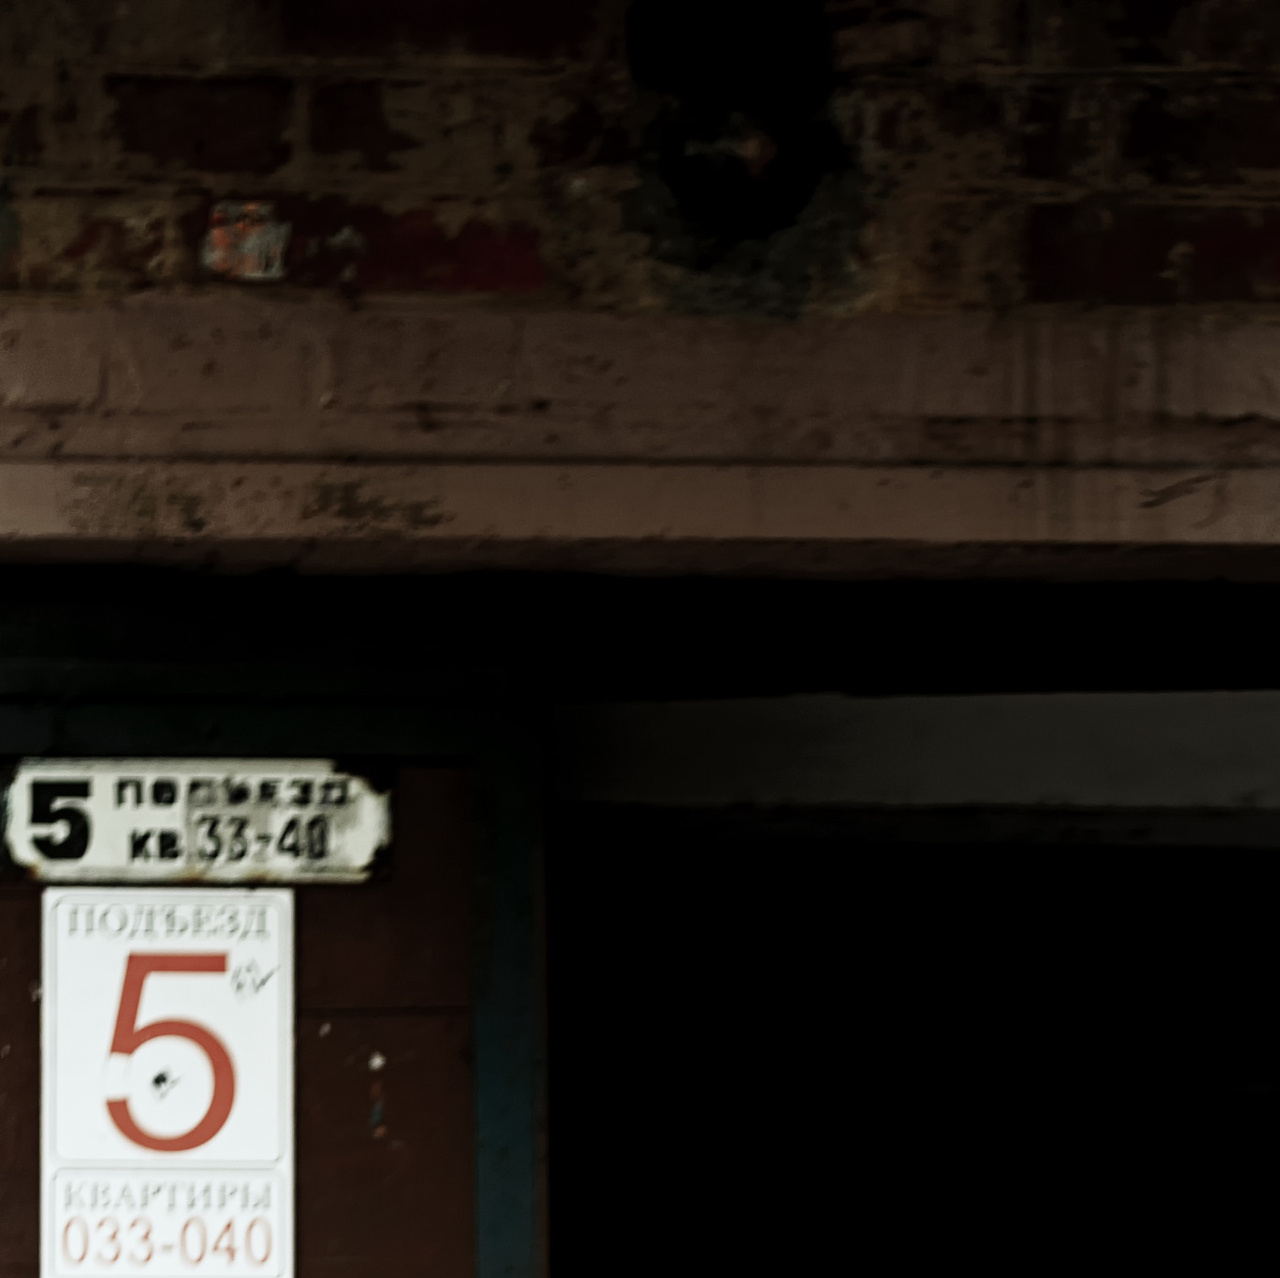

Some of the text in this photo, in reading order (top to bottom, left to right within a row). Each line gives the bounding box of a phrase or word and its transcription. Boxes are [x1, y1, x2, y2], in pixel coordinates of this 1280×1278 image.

[30, 779, 92, 860] 5
[196, 813, 330, 861] 33-40
[67, 903, 270, 939] ПОДЪЕЗД
[106, 952, 236, 1152] 5
[63, 1180, 273, 1210] КВАРТИРЫ
[61, 1215, 274, 1267] 033-040
